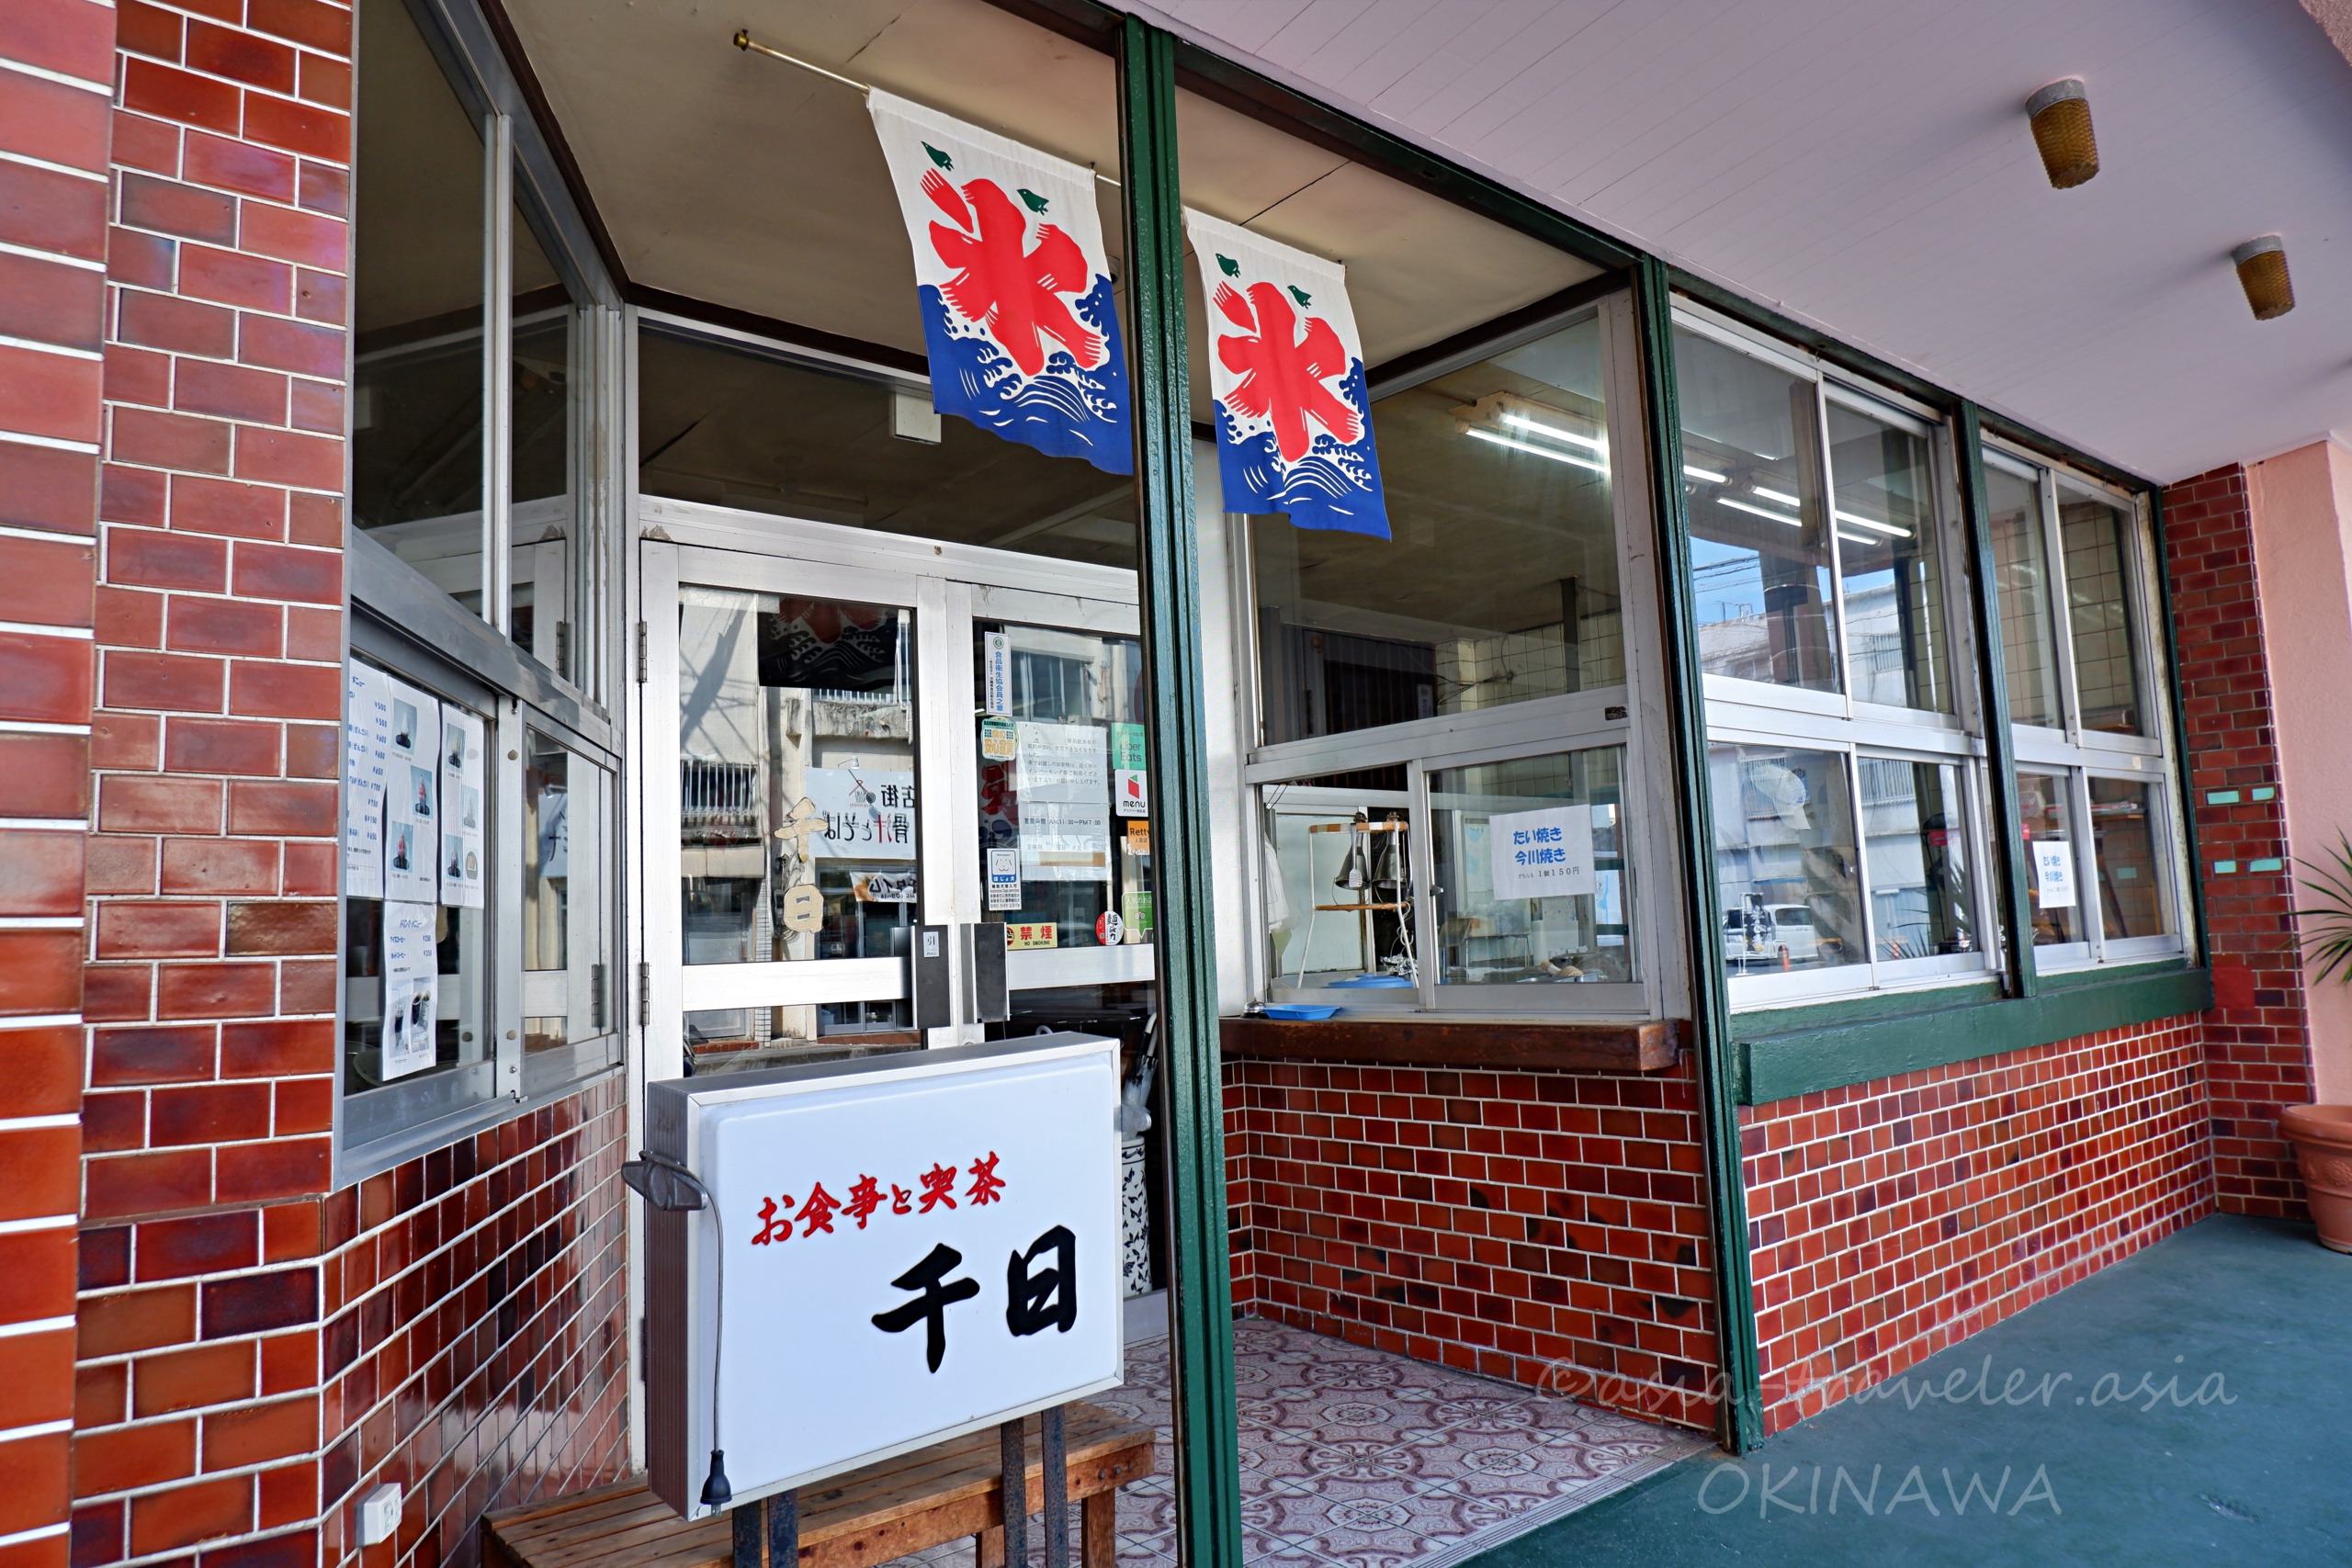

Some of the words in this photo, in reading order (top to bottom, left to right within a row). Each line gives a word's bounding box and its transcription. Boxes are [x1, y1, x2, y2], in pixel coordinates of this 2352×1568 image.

[995, 650, 1004, 712] 食品衛生協会員之章
[1120, 741, 1141, 751] Uber
[1121, 752, 1142, 762] Eats
[1123, 800, 1146, 808] menu
[1513, 827, 1563, 845] たい焼き
[1514, 848, 1566, 866] 今川焼き
[1020, 925, 1053, 940] 禁煙
[751, 1151, 1006, 1247] お食事と喫茶
[871, 1224, 1078, 1374] 千日
